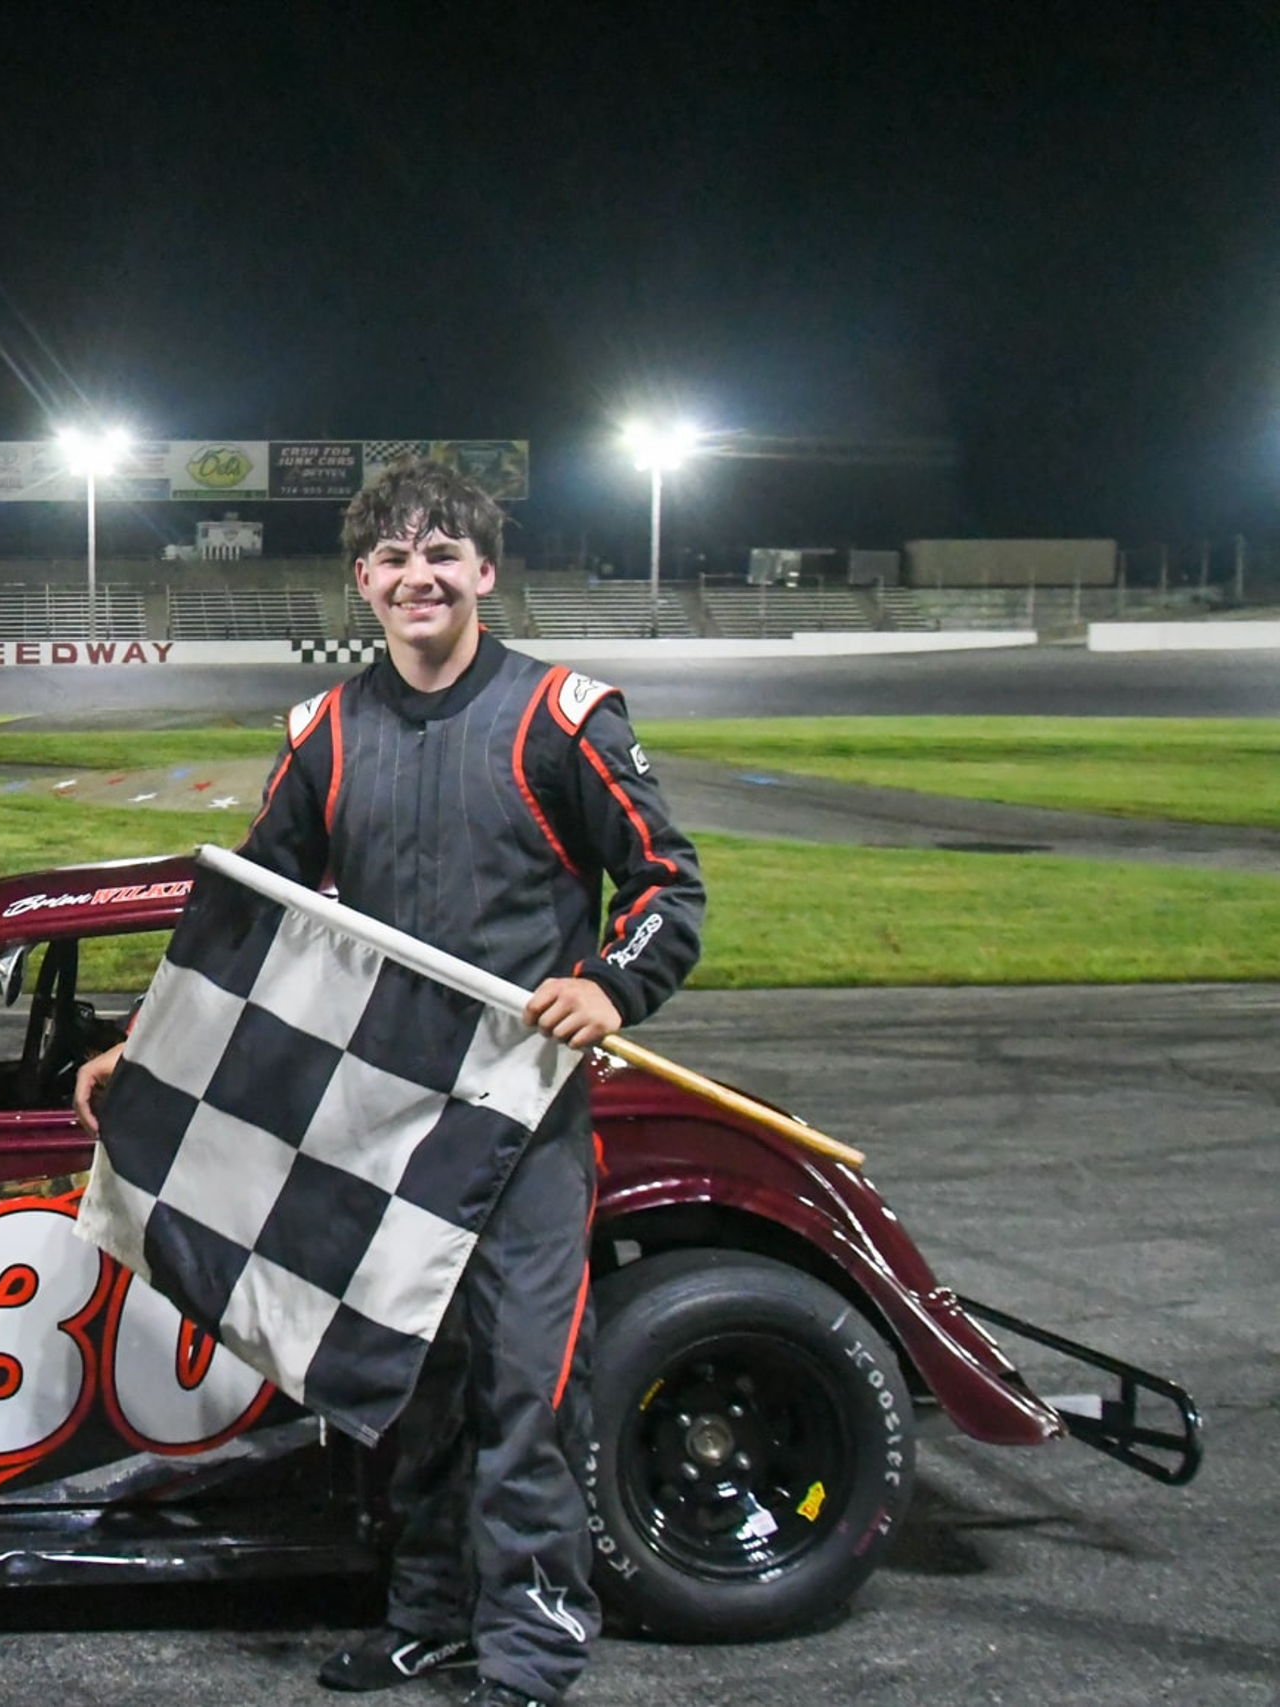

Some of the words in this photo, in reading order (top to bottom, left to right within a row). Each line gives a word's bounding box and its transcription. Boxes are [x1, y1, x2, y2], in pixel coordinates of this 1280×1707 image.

[278, 457, 314, 466] JUNK
[317, 456, 355, 466] CARS
[2, 894, 94, 918] Brian
